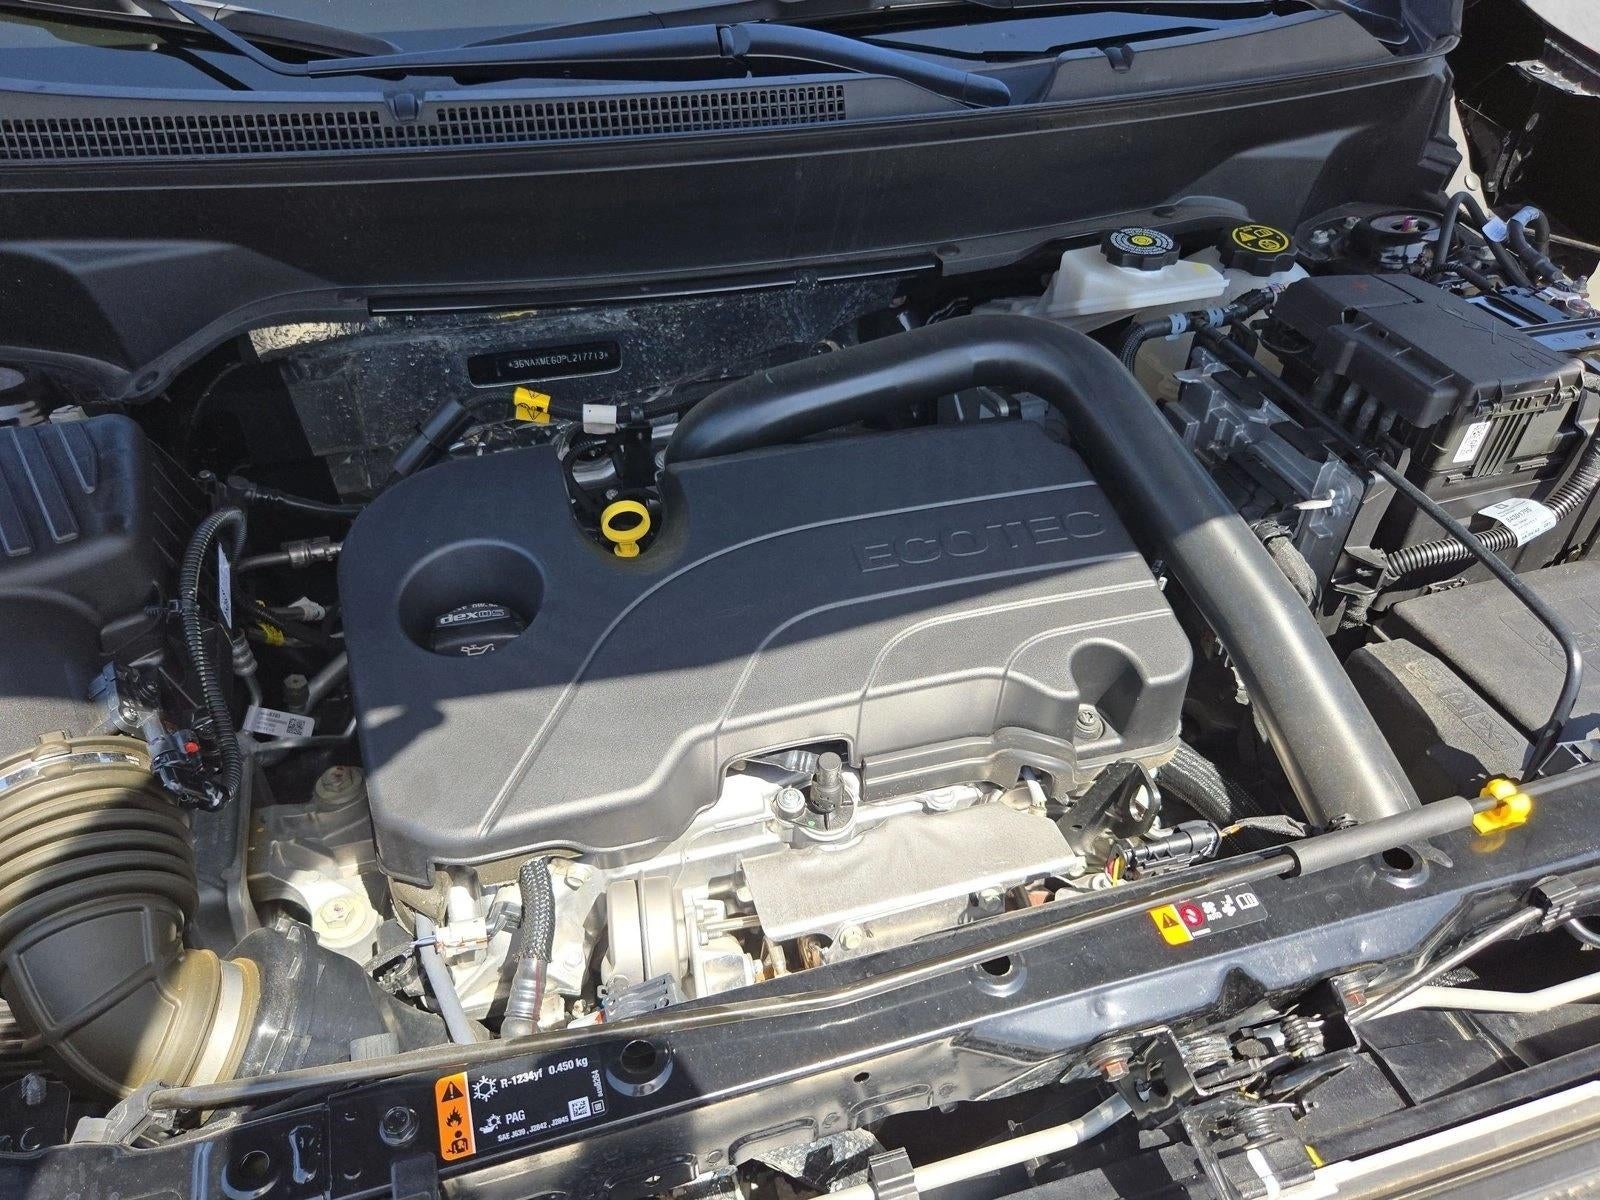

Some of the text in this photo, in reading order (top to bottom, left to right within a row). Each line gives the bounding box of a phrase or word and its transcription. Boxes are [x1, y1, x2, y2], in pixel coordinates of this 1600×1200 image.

[853, 511, 1106, 573] ECOTEC
[440, 609, 505, 625] dexos
[500, 1057, 588, 1089] R-1234yf 0.450 kg
[505, 1110, 526, 1125] PAG
[497, 1133, 511, 1142] SAE
